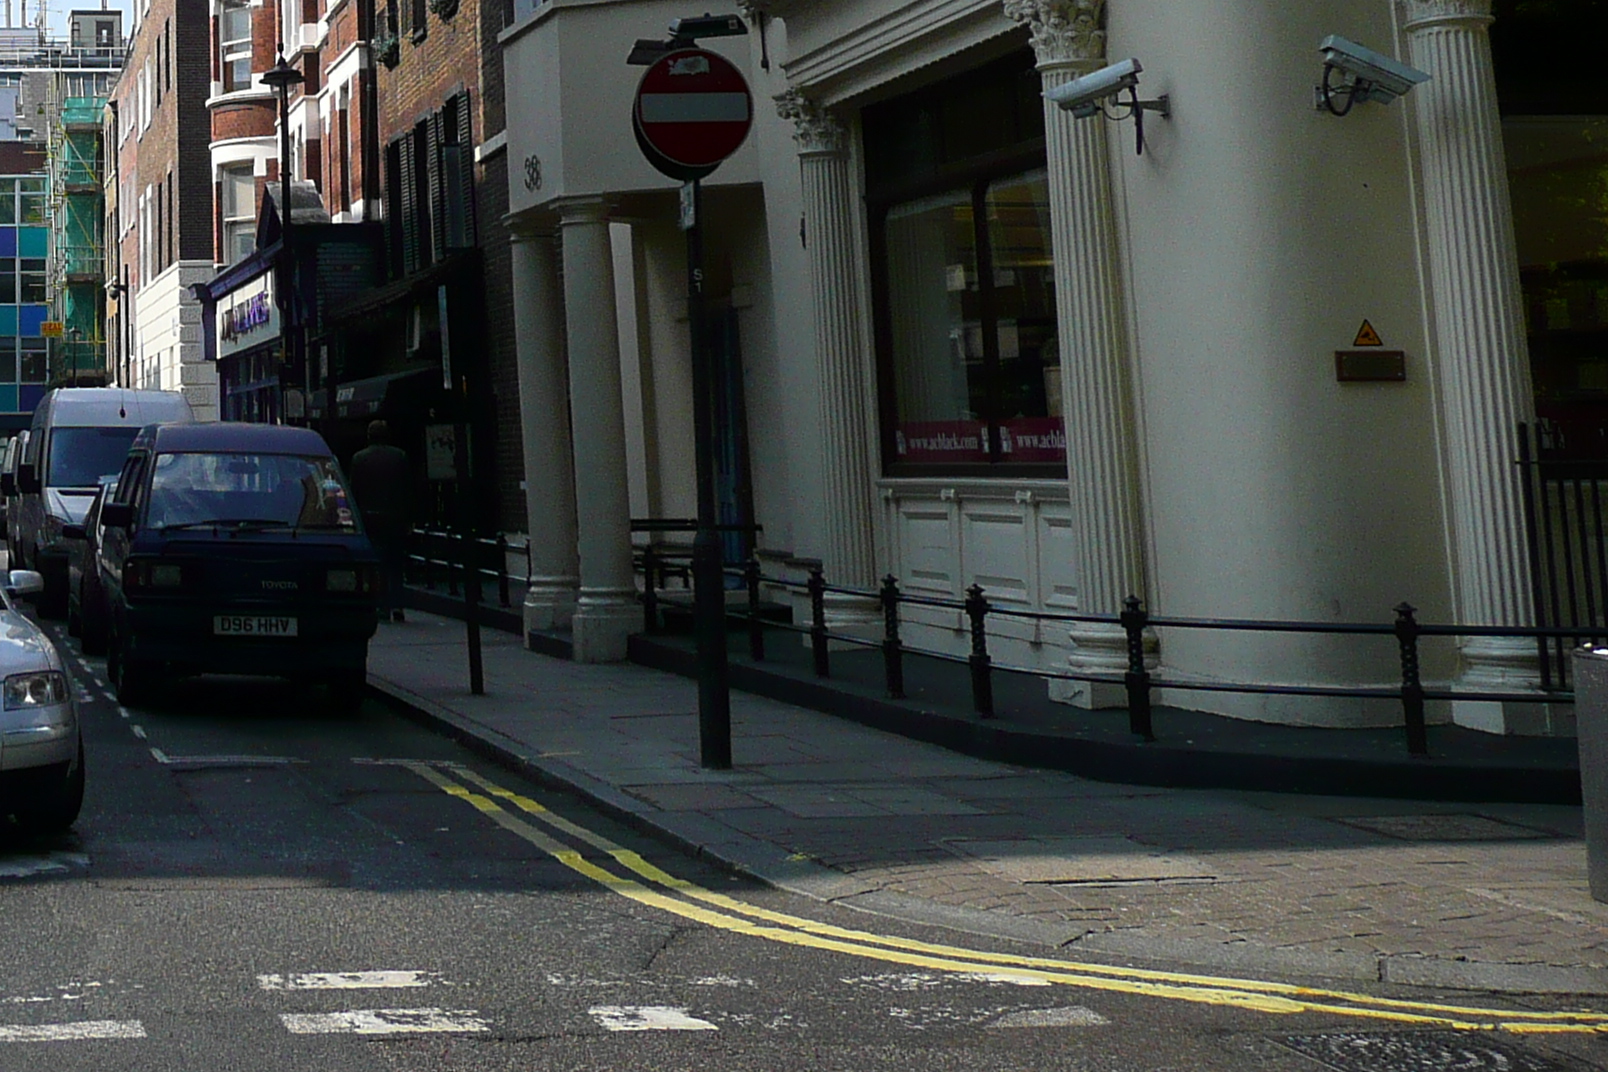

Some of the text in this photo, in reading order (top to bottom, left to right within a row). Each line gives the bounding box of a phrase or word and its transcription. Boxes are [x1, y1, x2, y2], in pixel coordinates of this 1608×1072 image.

[261, 580, 299, 590] TOYOTA
[221, 617, 290, 632] D96 HHV
